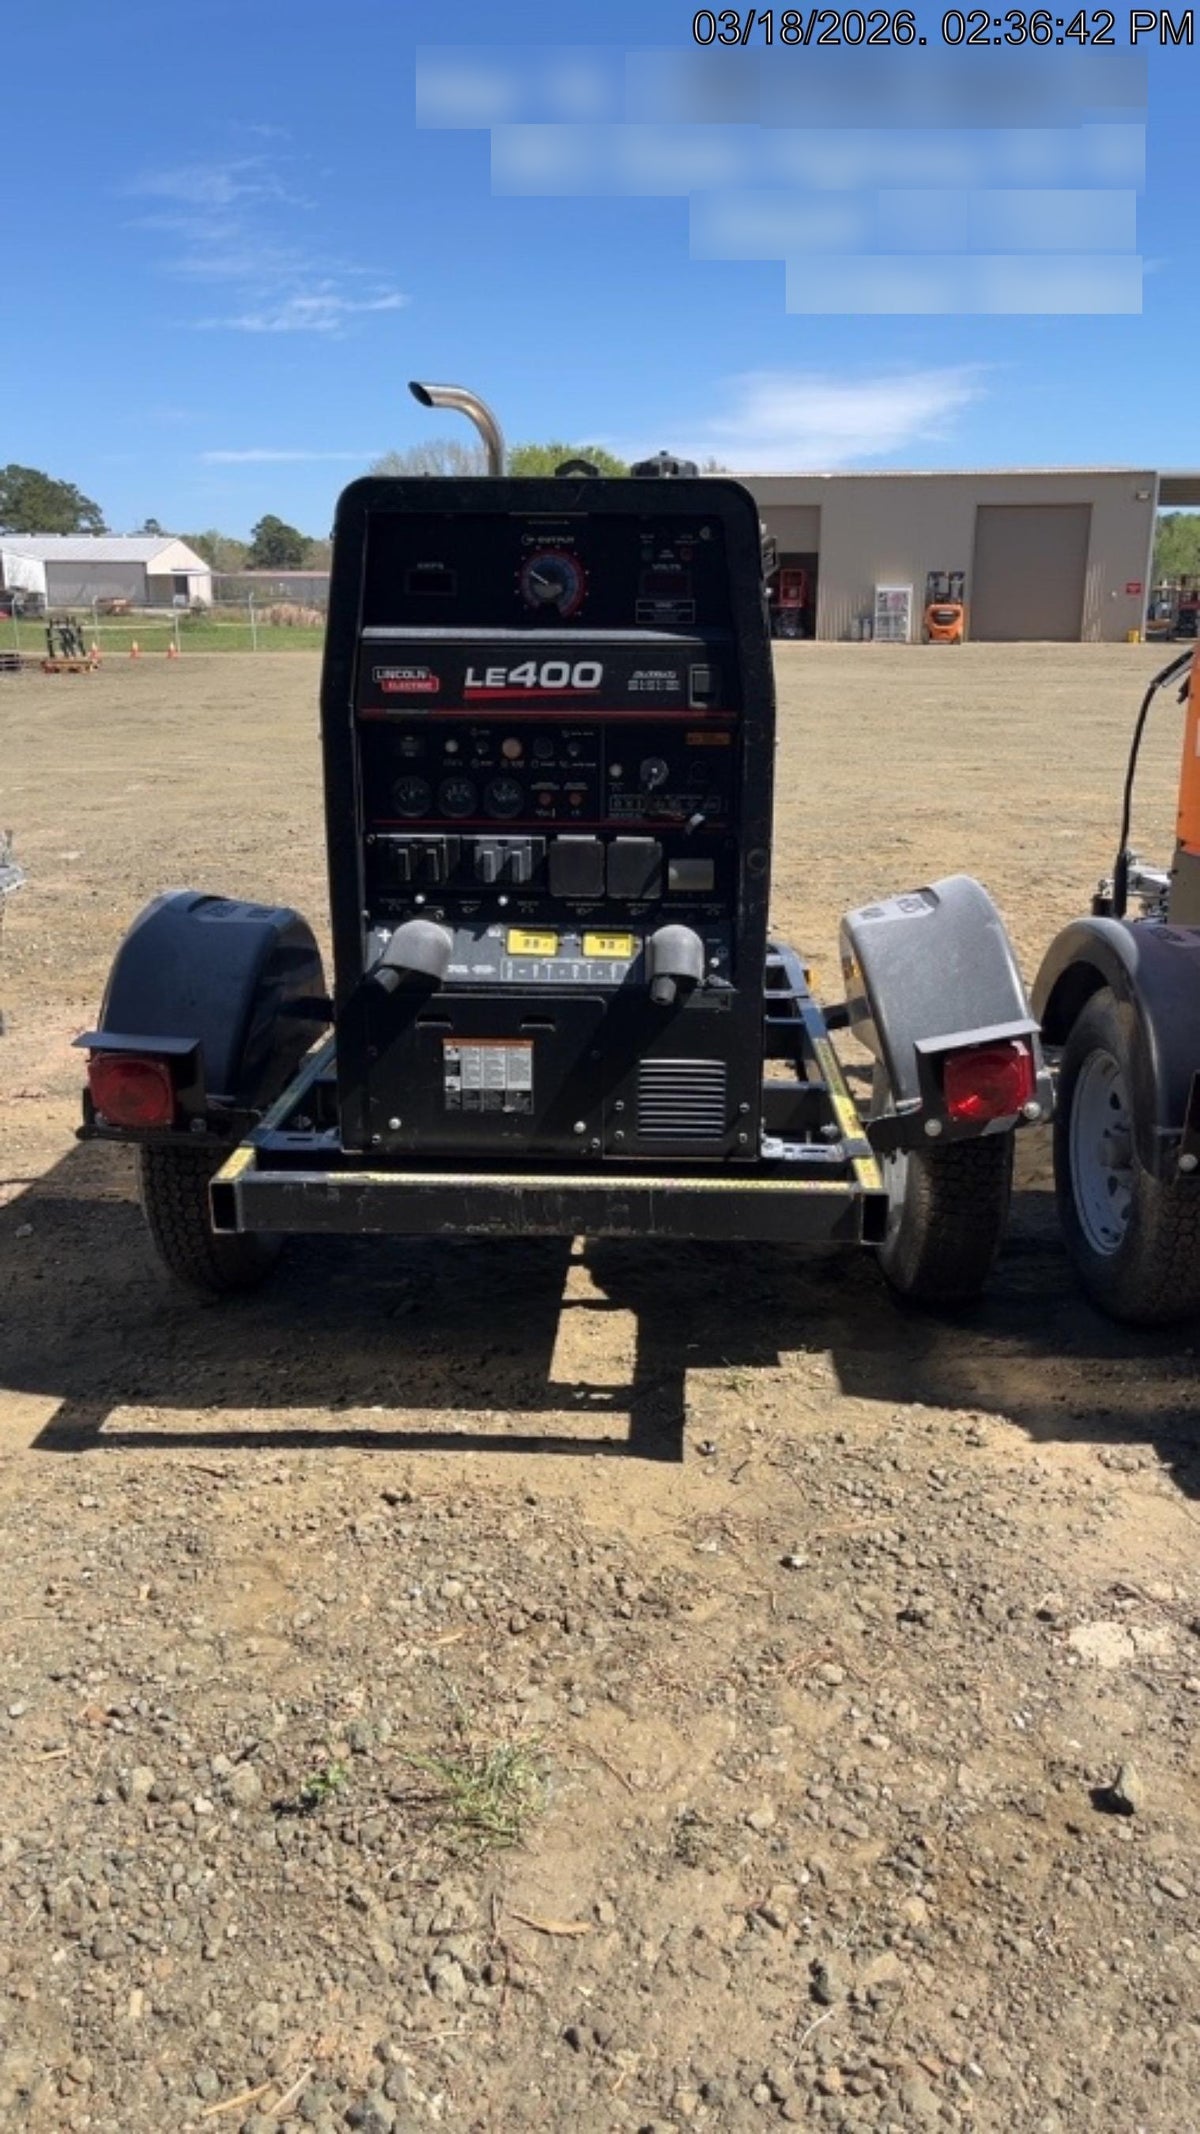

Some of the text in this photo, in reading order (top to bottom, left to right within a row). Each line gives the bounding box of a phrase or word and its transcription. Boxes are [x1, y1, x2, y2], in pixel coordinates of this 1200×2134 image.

[376, 669, 428, 680] LINCOLN
[464, 660, 604, 689] LE400
[387, 681, 434, 690] ELECTRIC
